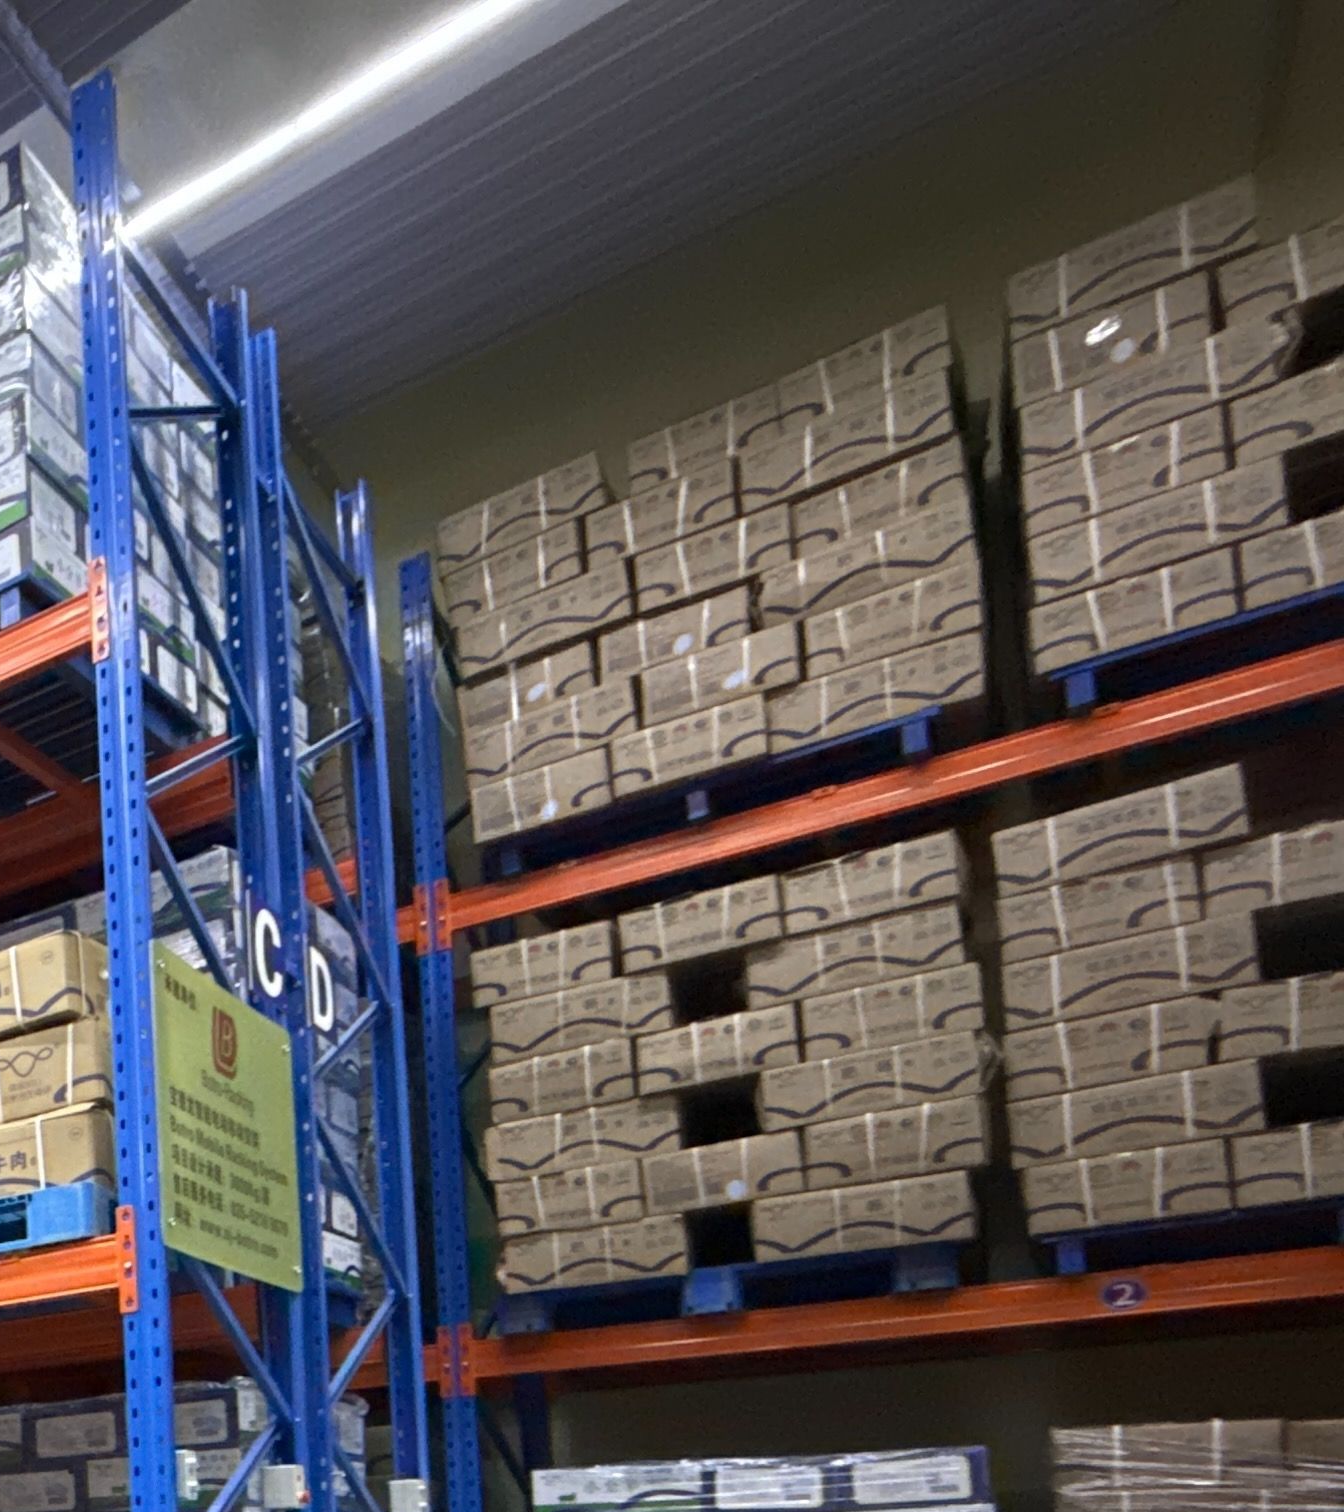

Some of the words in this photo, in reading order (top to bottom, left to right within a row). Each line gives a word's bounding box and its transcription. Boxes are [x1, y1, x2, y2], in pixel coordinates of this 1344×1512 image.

[254, 908, 284, 998] C
[309, 950, 333, 1031] D
[1112, 1283, 1137, 1307] 2
